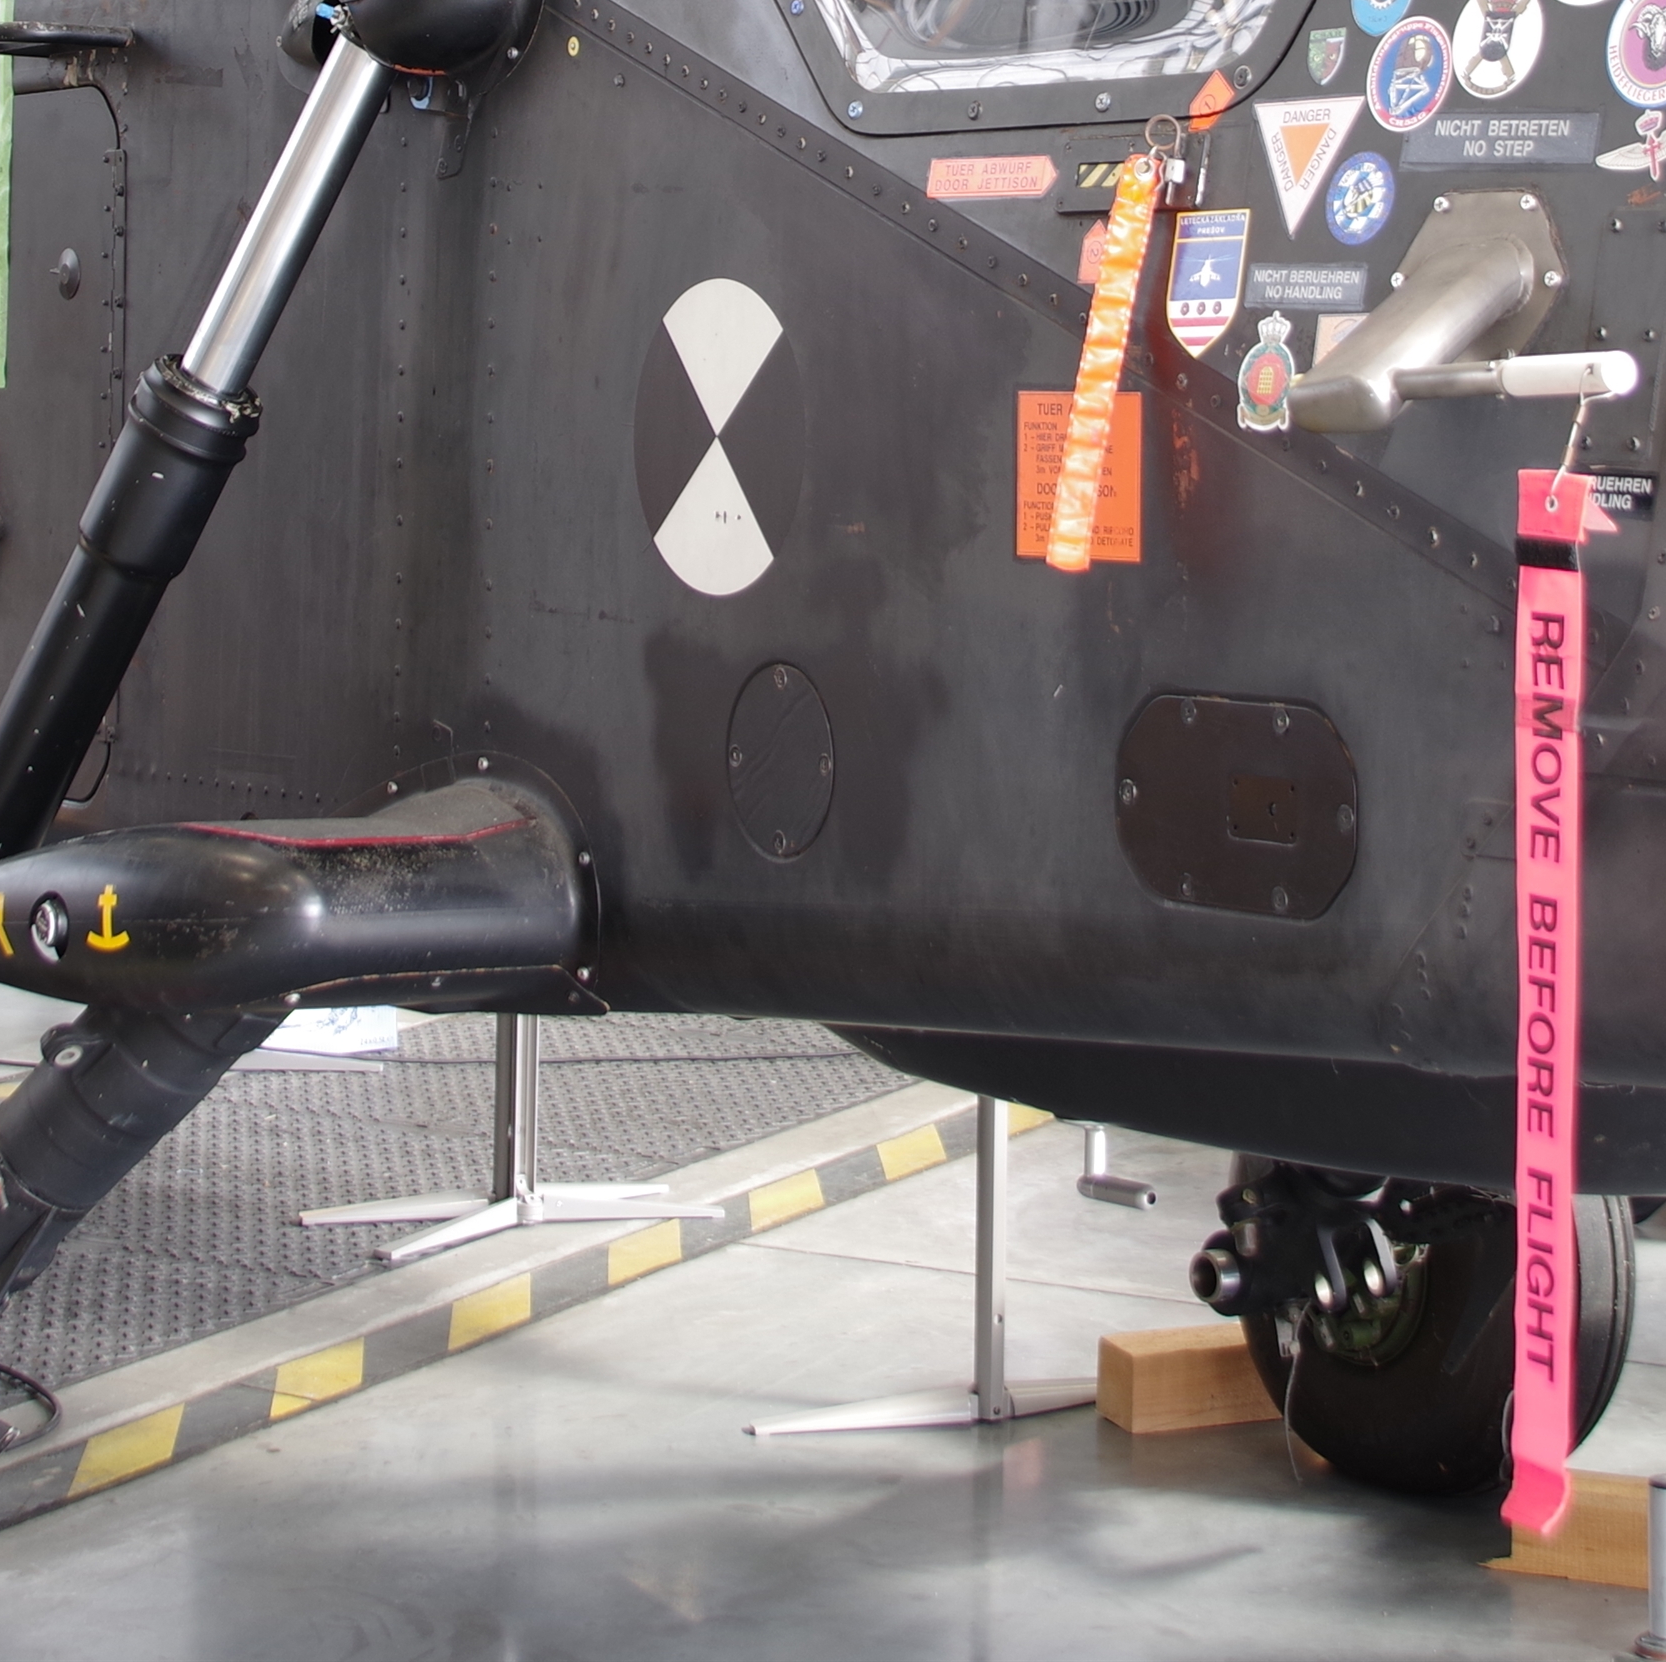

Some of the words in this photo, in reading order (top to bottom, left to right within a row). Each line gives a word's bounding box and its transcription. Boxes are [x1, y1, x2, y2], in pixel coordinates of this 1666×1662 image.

[1608, 44, 1666, 102] HEIDEFLIEGER
[1283, 107, 1331, 124] DANGER
[1434, 119, 1481, 136] NICHT
[1487, 119, 1570, 136] BETRETEN
[1463, 140, 1490, 156] NO
[1493, 140, 1534, 157] STEP
[945, 163, 975, 176] TUER
[982, 161, 1032, 175] ABWURF
[1271, 131, 1294, 193] DANGER
[1300, 129, 1337, 192] DANGER
[935, 179, 969, 192] DOOR
[977, 176, 1038, 190] JETTISON
[1253, 269, 1288, 283] NICHT
[1289, 269, 1360, 284] BERUEHREN
[1264, 285, 1282, 298] NO
[1284, 285, 1342, 300] HANDLING
[1037, 403, 1063, 416] TUER
[1023, 422, 1058, 431] FUNKTION
[1036, 433, 1053, 442] HIER
[1036, 444, 1056, 453] GRIFF
[1036, 455, 1062, 464] FASSEN
[1589, 475, 1652, 494] RUEHREN
[1531, 611, 1566, 865] REMOVE
[1527, 894, 1558, 1137] BEFORE
[1525, 1167, 1556, 1383] FLIGHT
